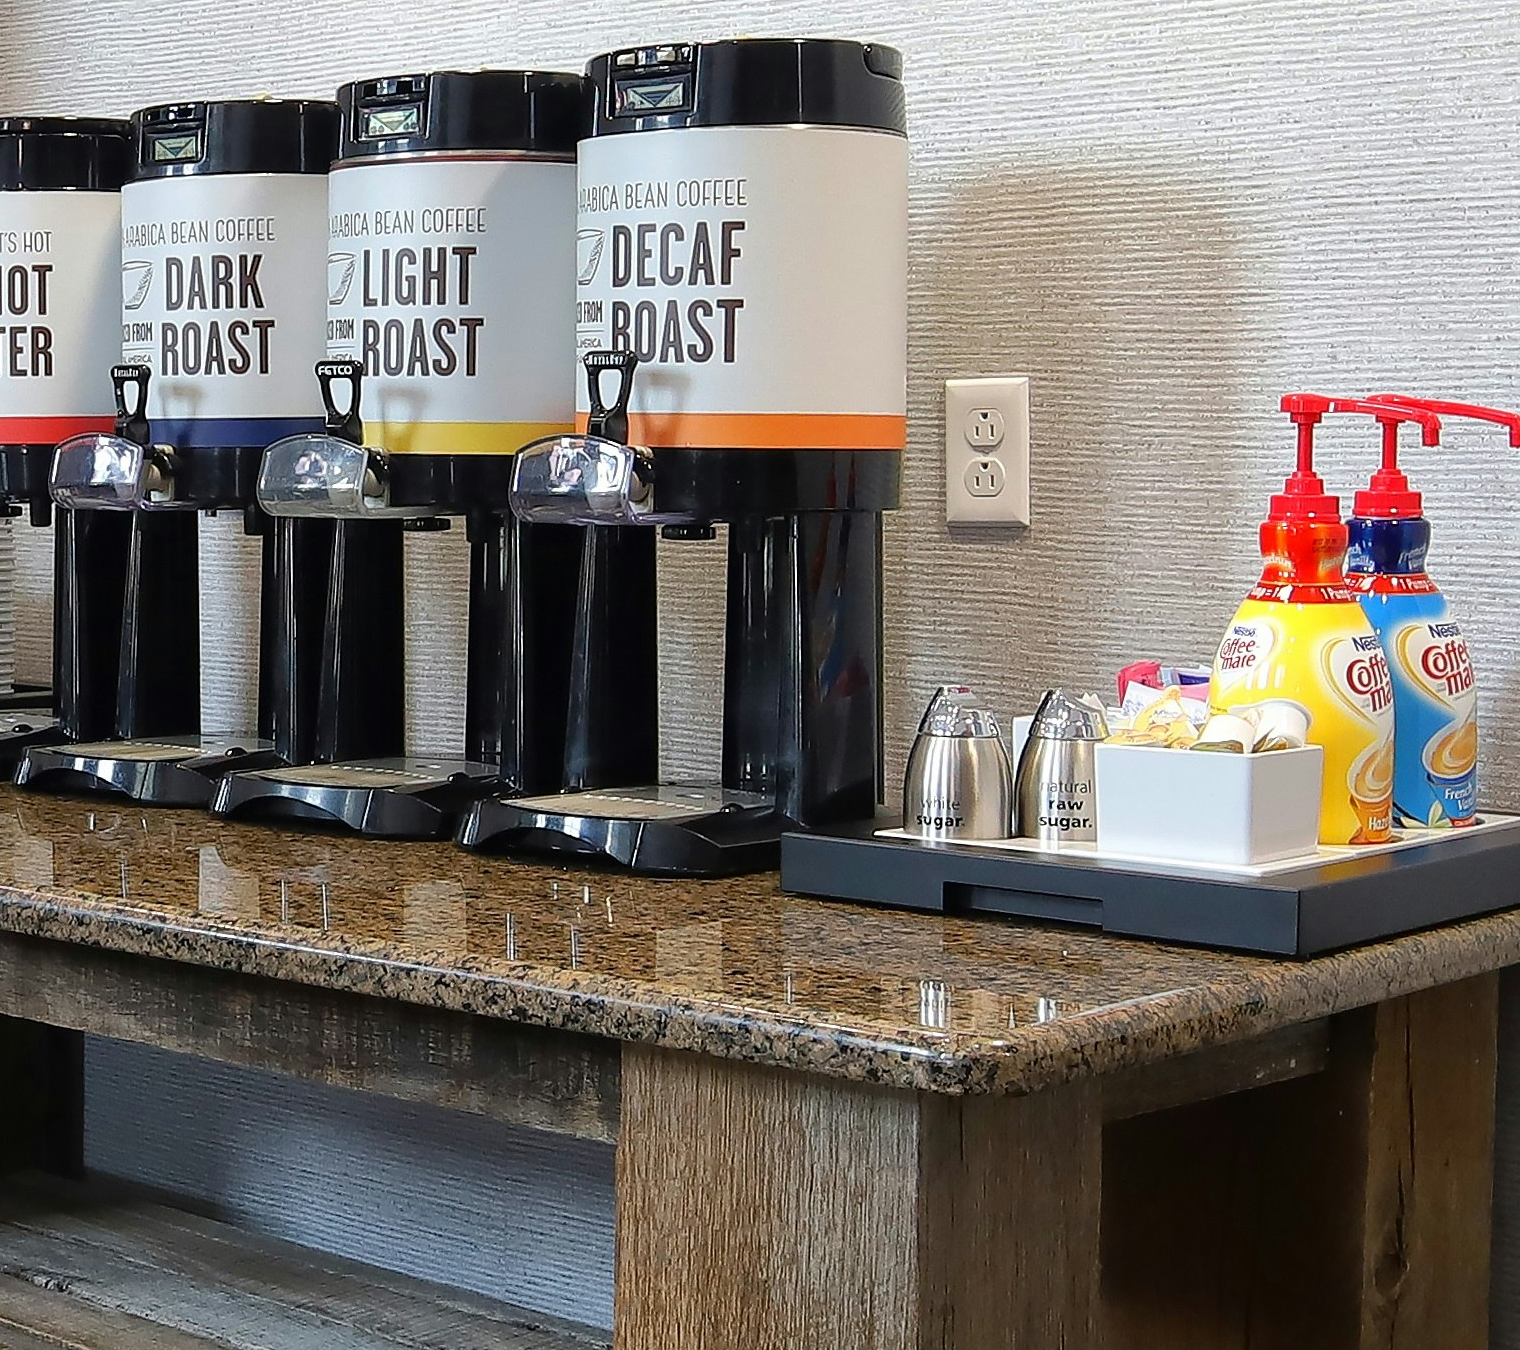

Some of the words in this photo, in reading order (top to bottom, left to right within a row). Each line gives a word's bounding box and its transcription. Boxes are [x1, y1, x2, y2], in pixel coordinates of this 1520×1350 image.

[625, 182, 668, 209] BEAN
[677, 179, 748, 207] COFFEE
[171, 220, 208, 244] BEAN
[215, 218, 276, 242] COFFEE
[374, 209, 414, 235] BEAN
[421, 207, 487, 233] COFFEE
[23, 231, 53, 253] HOT
[612, 221, 745, 288] DECAF
[165, 254, 265, 311] DARK
[363, 246, 478, 307] LIGHT
[132, 322, 153, 342] FROM
[612, 299, 745, 363] ROAST
[161, 319, 276, 376] ROAST
[362, 317, 485, 377] ROAST
[1346, 653, 1389, 695] Coffe
[1040, 779, 1093, 794] natural
[920, 796, 961, 811] white
[1048, 800, 1084, 811] raw
[1039, 816, 1093, 831] sugar.
